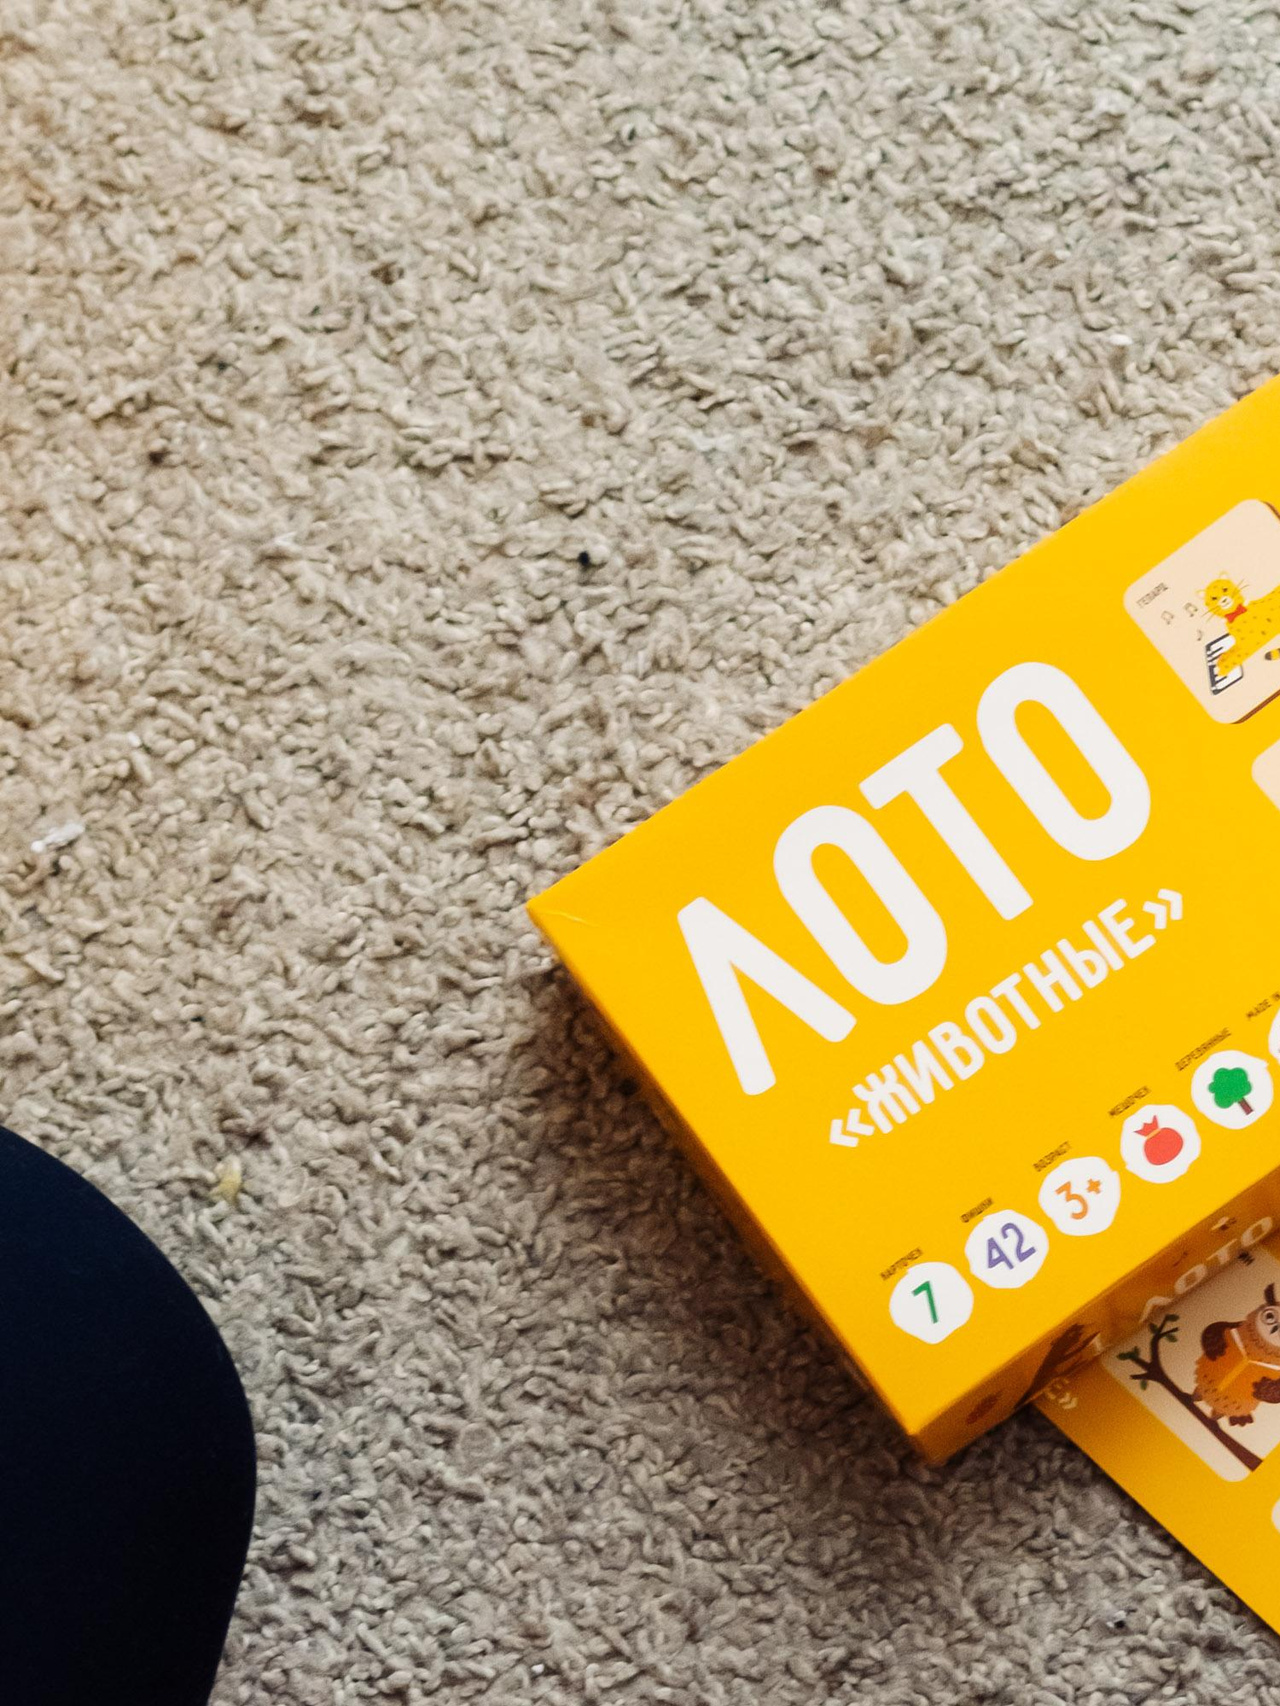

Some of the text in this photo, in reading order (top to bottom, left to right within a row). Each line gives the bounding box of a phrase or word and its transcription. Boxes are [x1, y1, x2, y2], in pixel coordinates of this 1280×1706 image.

[677, 662, 1151, 1095] ЛОТО
[829, 888, 1182, 1147] «ЖИВОТНЫЕ»
[1246, 998, 1273, 1019] MADE
[1055, 1178, 1101, 1219] 3+
[987, 1223, 1036, 1270] 42
[912, 1280, 938, 1323] 7
